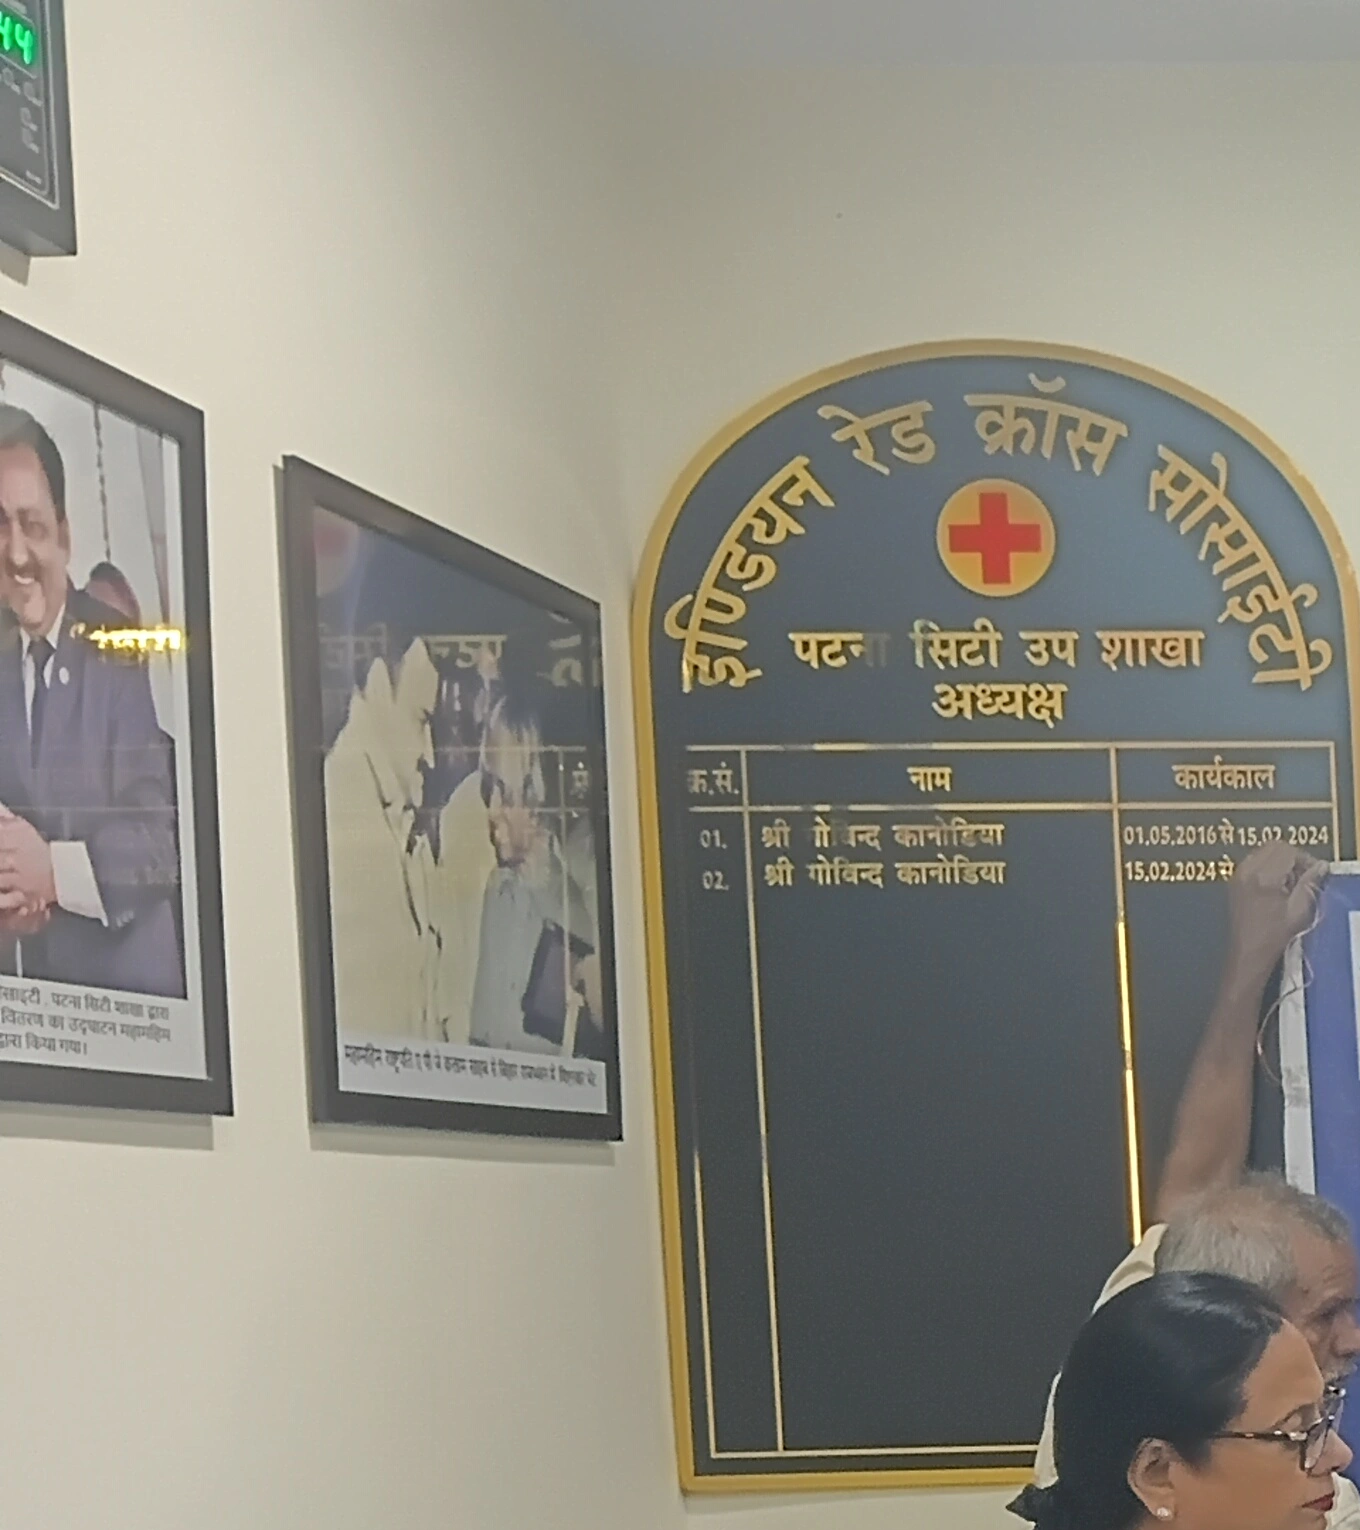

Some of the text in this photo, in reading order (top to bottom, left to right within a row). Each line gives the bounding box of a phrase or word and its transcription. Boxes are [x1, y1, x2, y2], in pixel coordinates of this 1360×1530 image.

[817, 401, 938, 476] रेड
[964, 373, 1128, 477] क्रॉस
[909, 617, 1003, 669] सिटी
[1019, 631, 1079, 668] उप
[1095, 631, 1205, 672] शाखा
[932, 682, 1068, 729] अध्यक्ष
[906, 766, 952, 791] नाम
[1171, 755, 1276, 790] कार्यकाल
[700, 829, 727, 849] 01.
[761, 818, 791, 848] श्री
[891, 815, 1005, 848] कानोडिया
[1123, 818, 1329, 846] 01.05.2016 से 15.022024
[702, 870, 730, 891] 02.
[764, 854, 1006, 888] श्री गोविन्द कानोडिया
[1125, 854, 1235, 882] 15.02.2024 से
